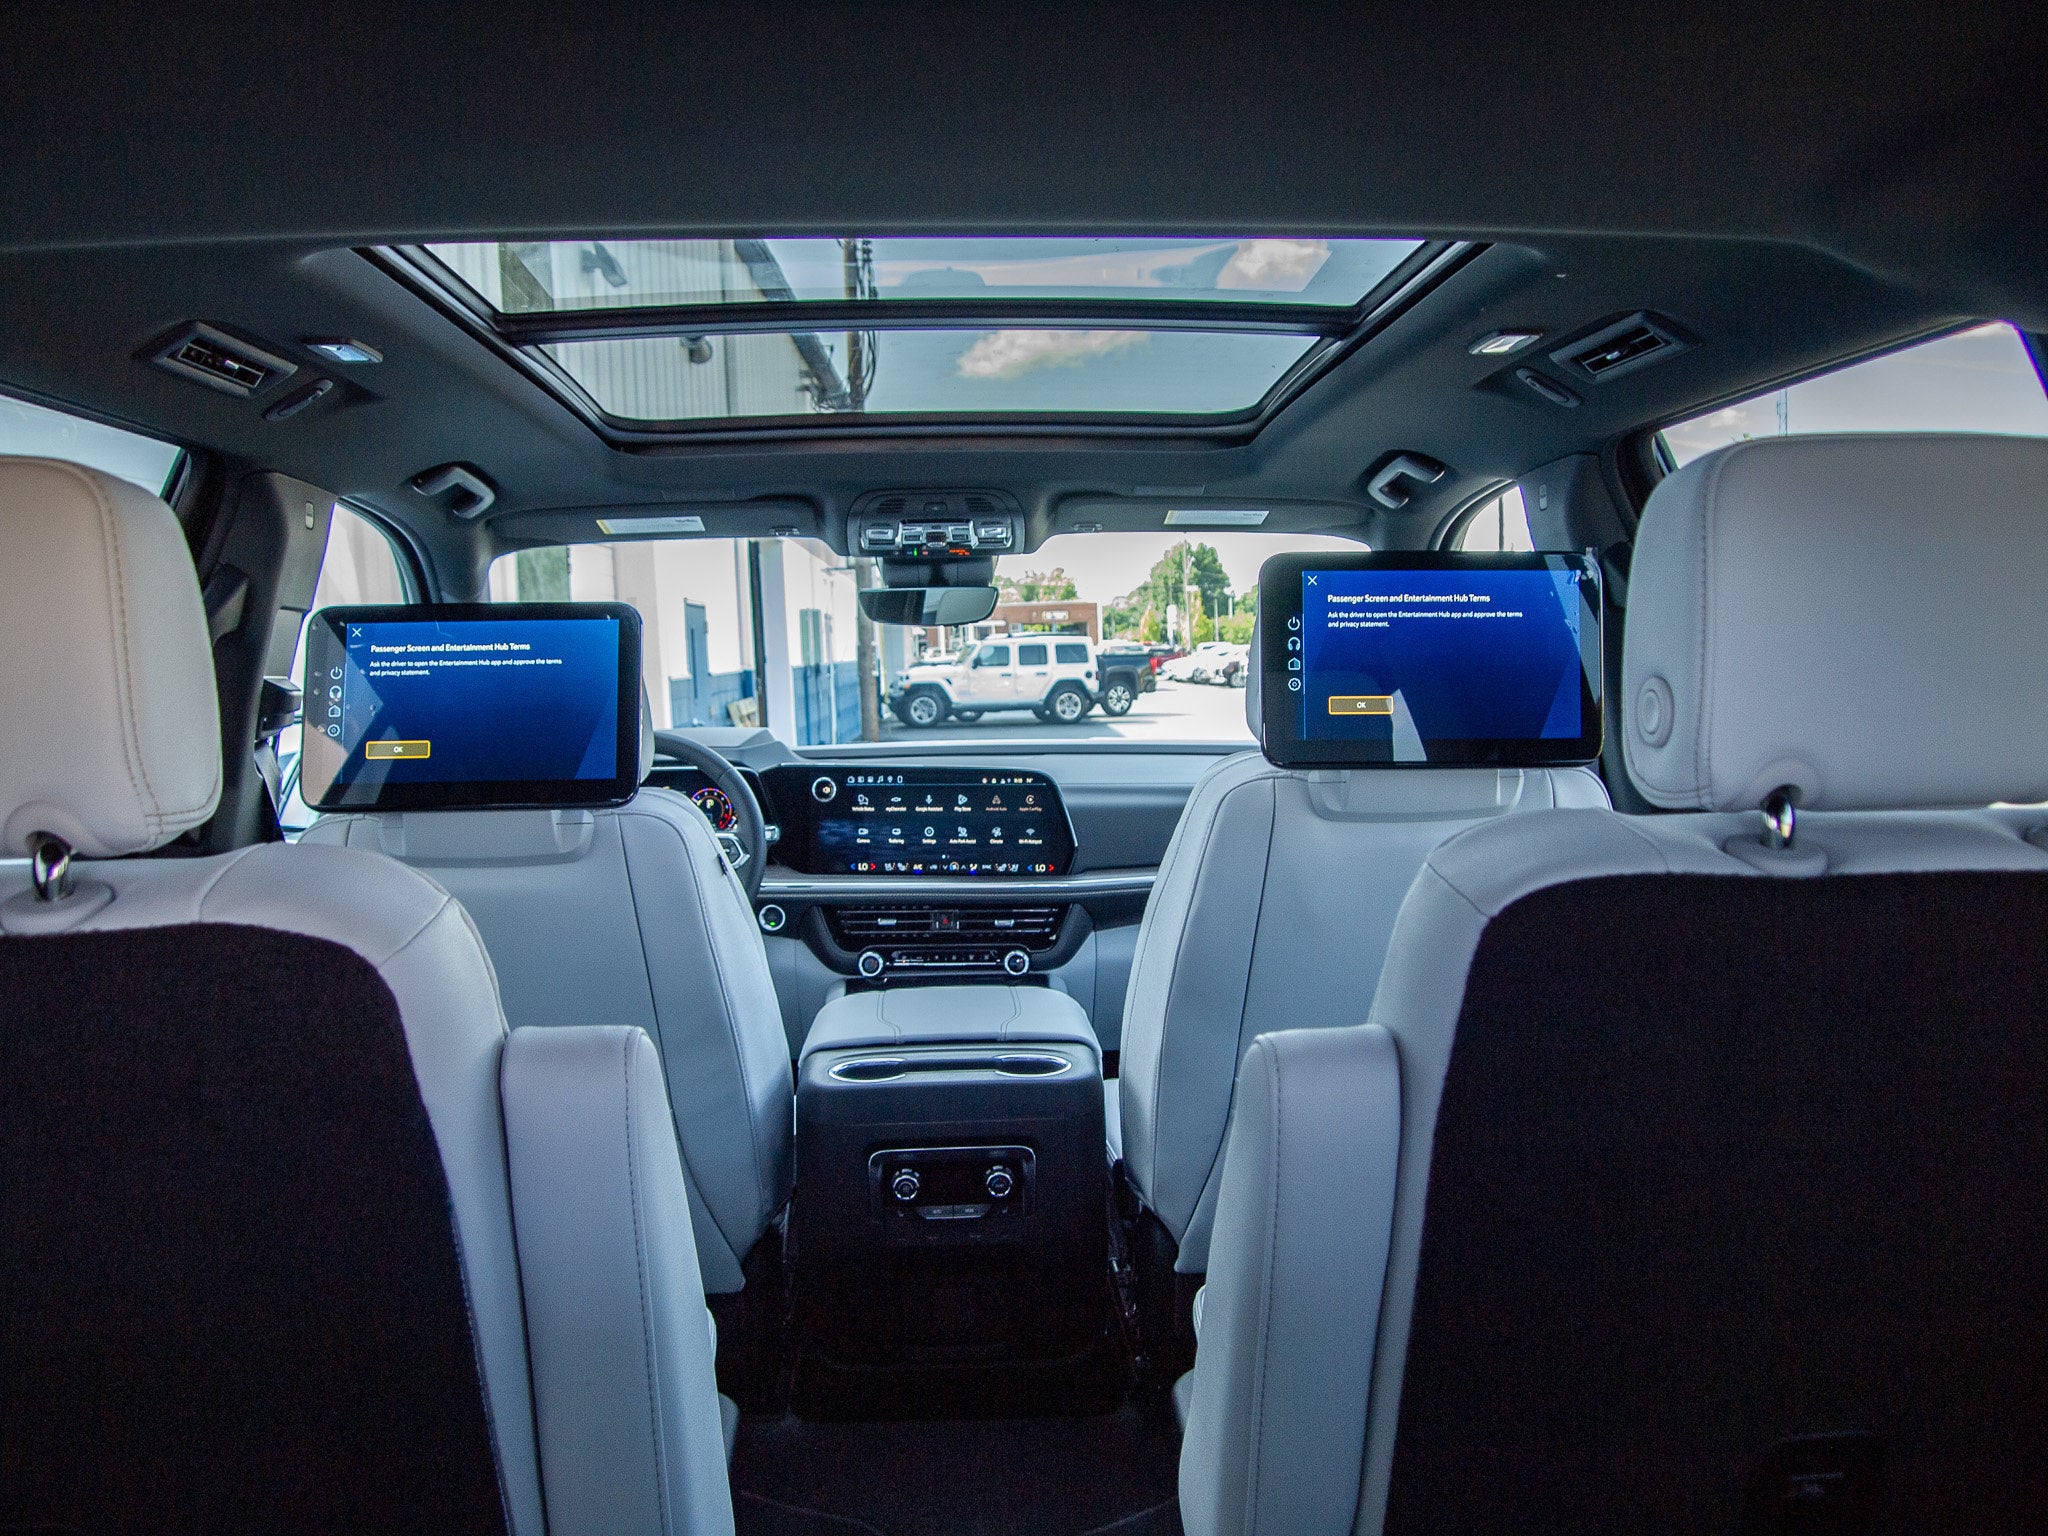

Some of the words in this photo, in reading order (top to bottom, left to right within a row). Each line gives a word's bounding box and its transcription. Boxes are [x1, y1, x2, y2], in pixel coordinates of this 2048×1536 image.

[1327, 594, 1364, 605] Passenger
[1364, 594, 1389, 603] Screen
[1389, 594, 1403, 603] and
[1403, 594, 1453, 603] Entertainment
[1453, 594, 1469, 602] Hub
[1468, 594, 1491, 602] Terms
[1339, 621, 1360, 629] privacy
[370, 644, 407, 654] Passenger
[406, 644, 431, 653] Screen
[430, 643, 445, 652] and
[445, 643, 493, 652] Entertainment
[494, 642, 509, 651] Hub
[509, 642, 531, 650] Terms
[439, 659, 478, 667] Entertainment
[369, 669, 381, 677] and
[381, 669, 400, 677] privacy
[1356, 701, 1367, 709] OK
[857, 862, 869, 871] LO
[1035, 863, 1046, 872] LO
